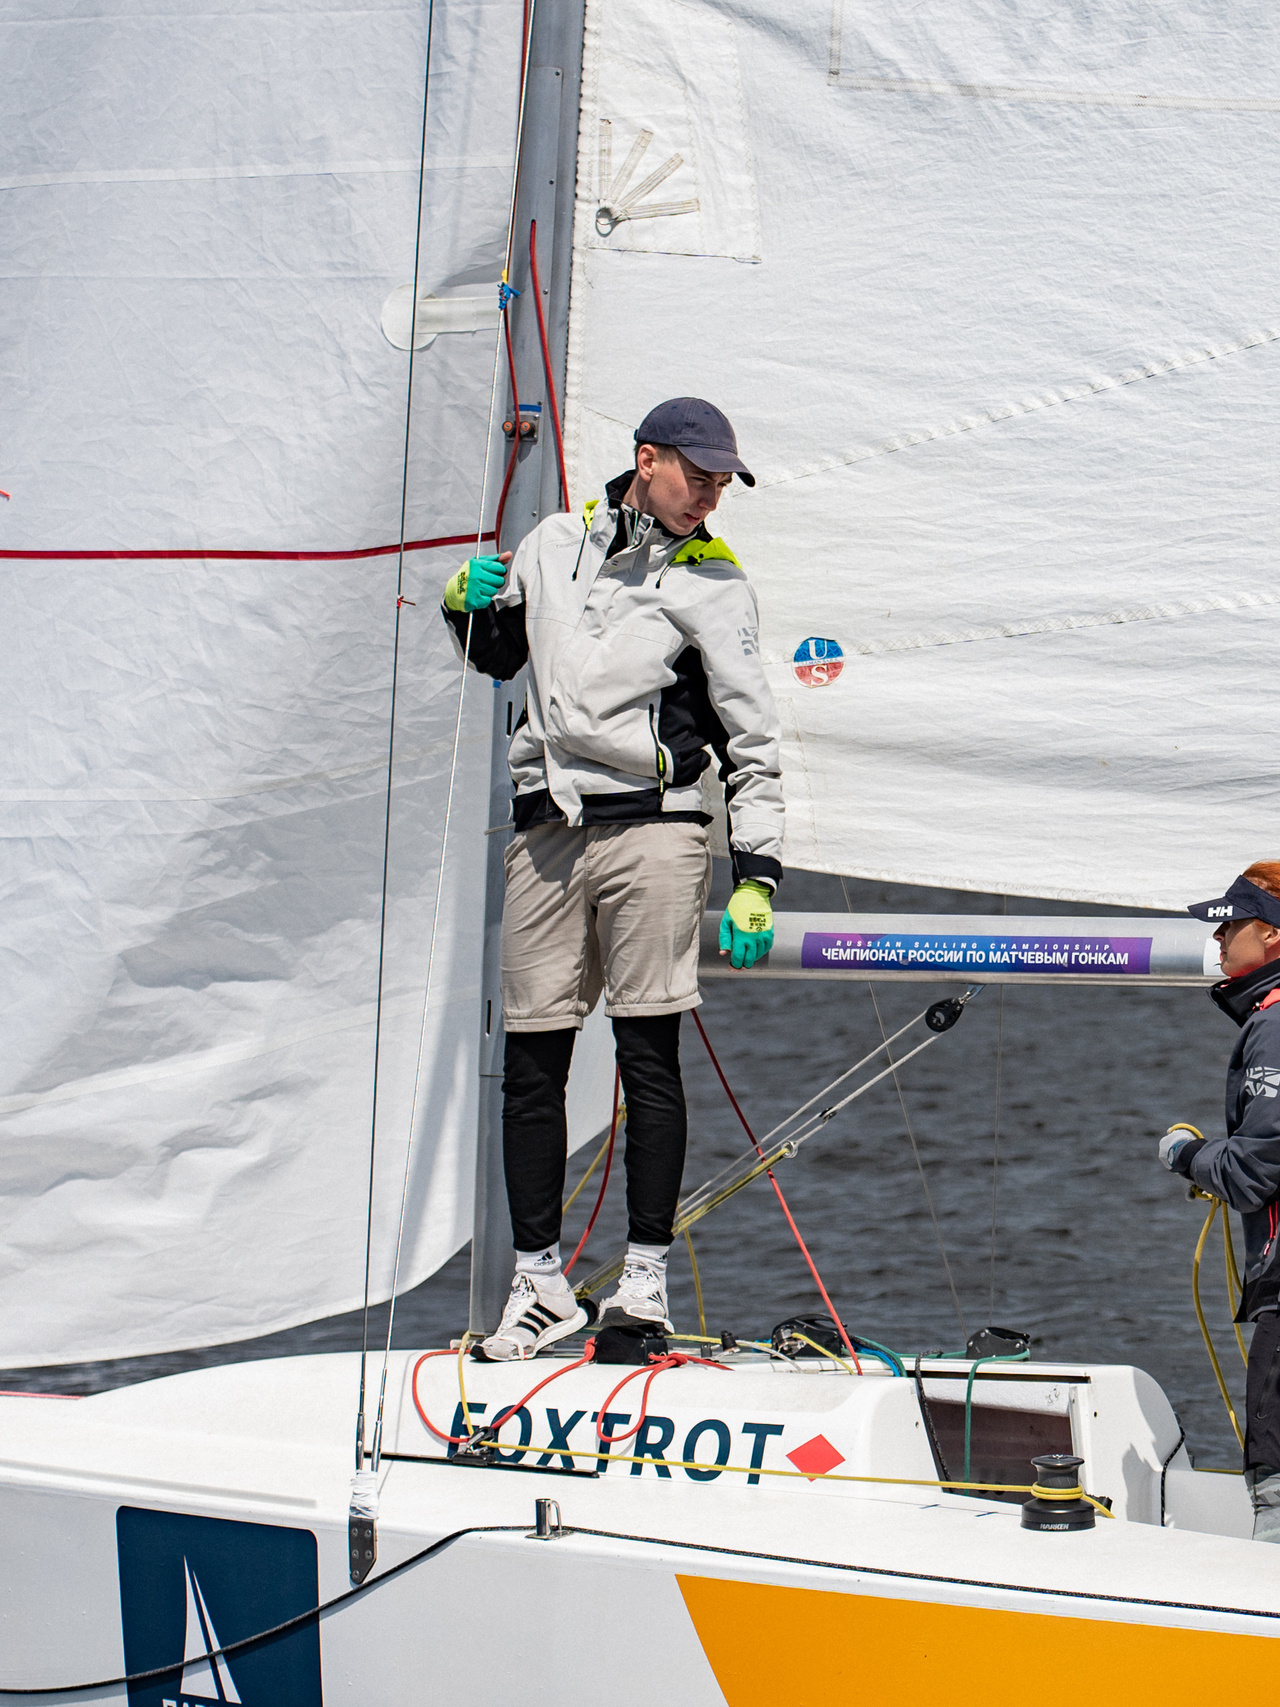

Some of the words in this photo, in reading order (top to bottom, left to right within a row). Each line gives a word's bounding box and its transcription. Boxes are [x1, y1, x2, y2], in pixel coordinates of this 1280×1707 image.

[1207, 906, 1233, 917] HH
[836, 940, 902, 948] RUSSIAN
[914, 941, 978, 949] SAILING
[822, 948, 906, 961] ЧЕМПИОНАТ
[908, 950, 963, 962] РОССИИ
[966, 951, 986, 963] ПО
[988, 951, 1068, 964] МАТЧЕВЫМ
[1071, 952, 1129, 965] ГОНКАМ
[446, 1401, 785, 1485] FOXTROT
